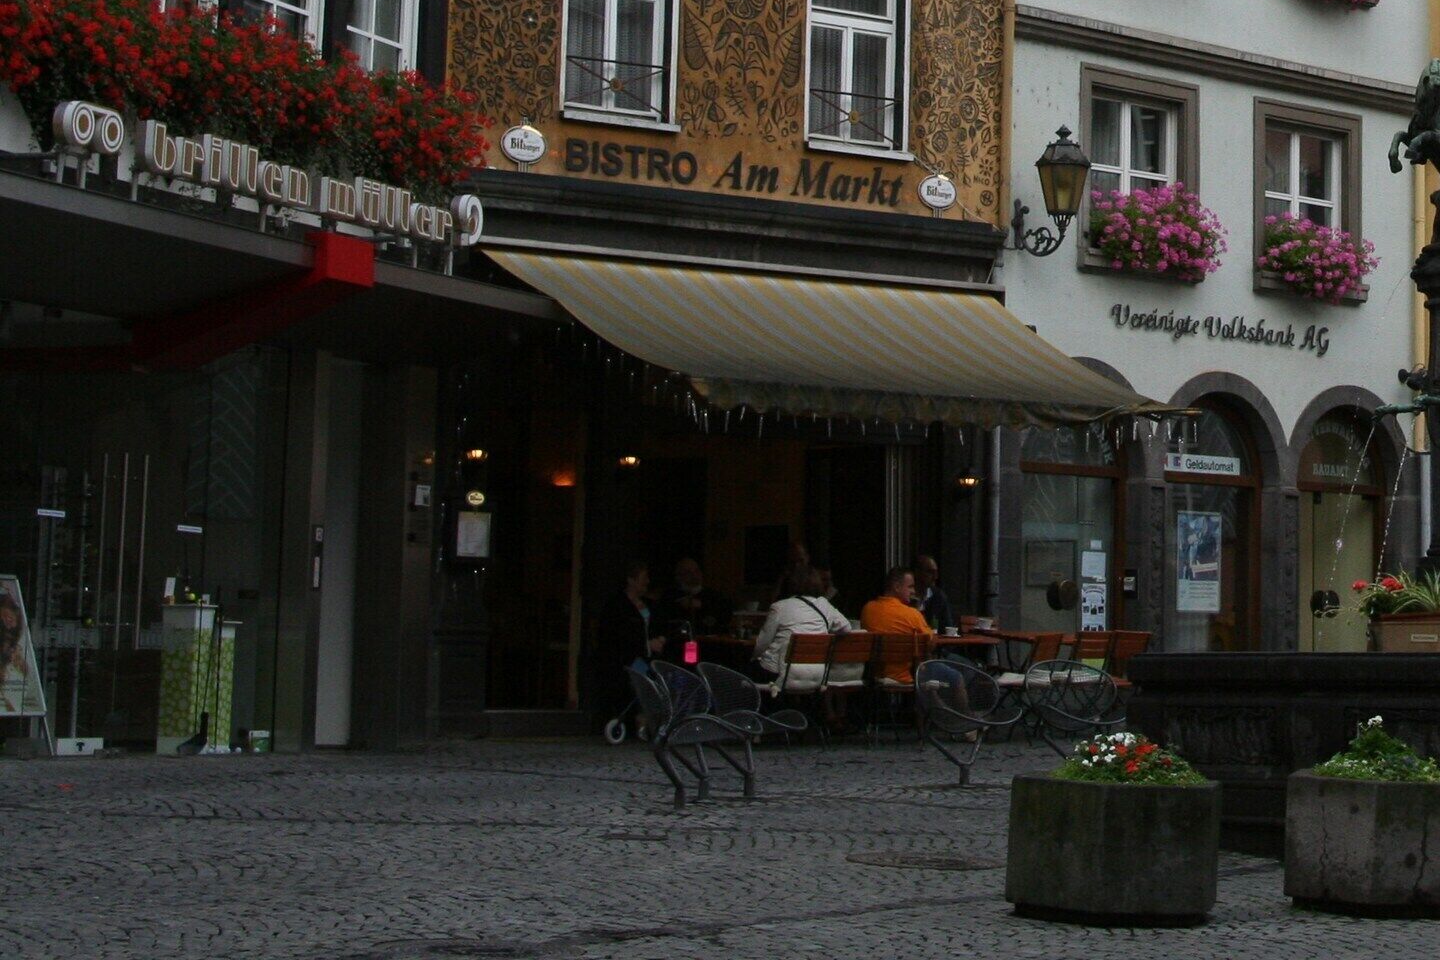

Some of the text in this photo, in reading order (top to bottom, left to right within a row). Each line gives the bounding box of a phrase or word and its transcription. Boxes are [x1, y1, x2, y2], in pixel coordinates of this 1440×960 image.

[144, 119, 454, 244] brillen müller
[565, 137, 906, 208] BISTRO Am Markt
[1111, 303, 1331, 358] Vereinigte Volksbank AG
[1185, 457, 1234, 472] Geldautomat
